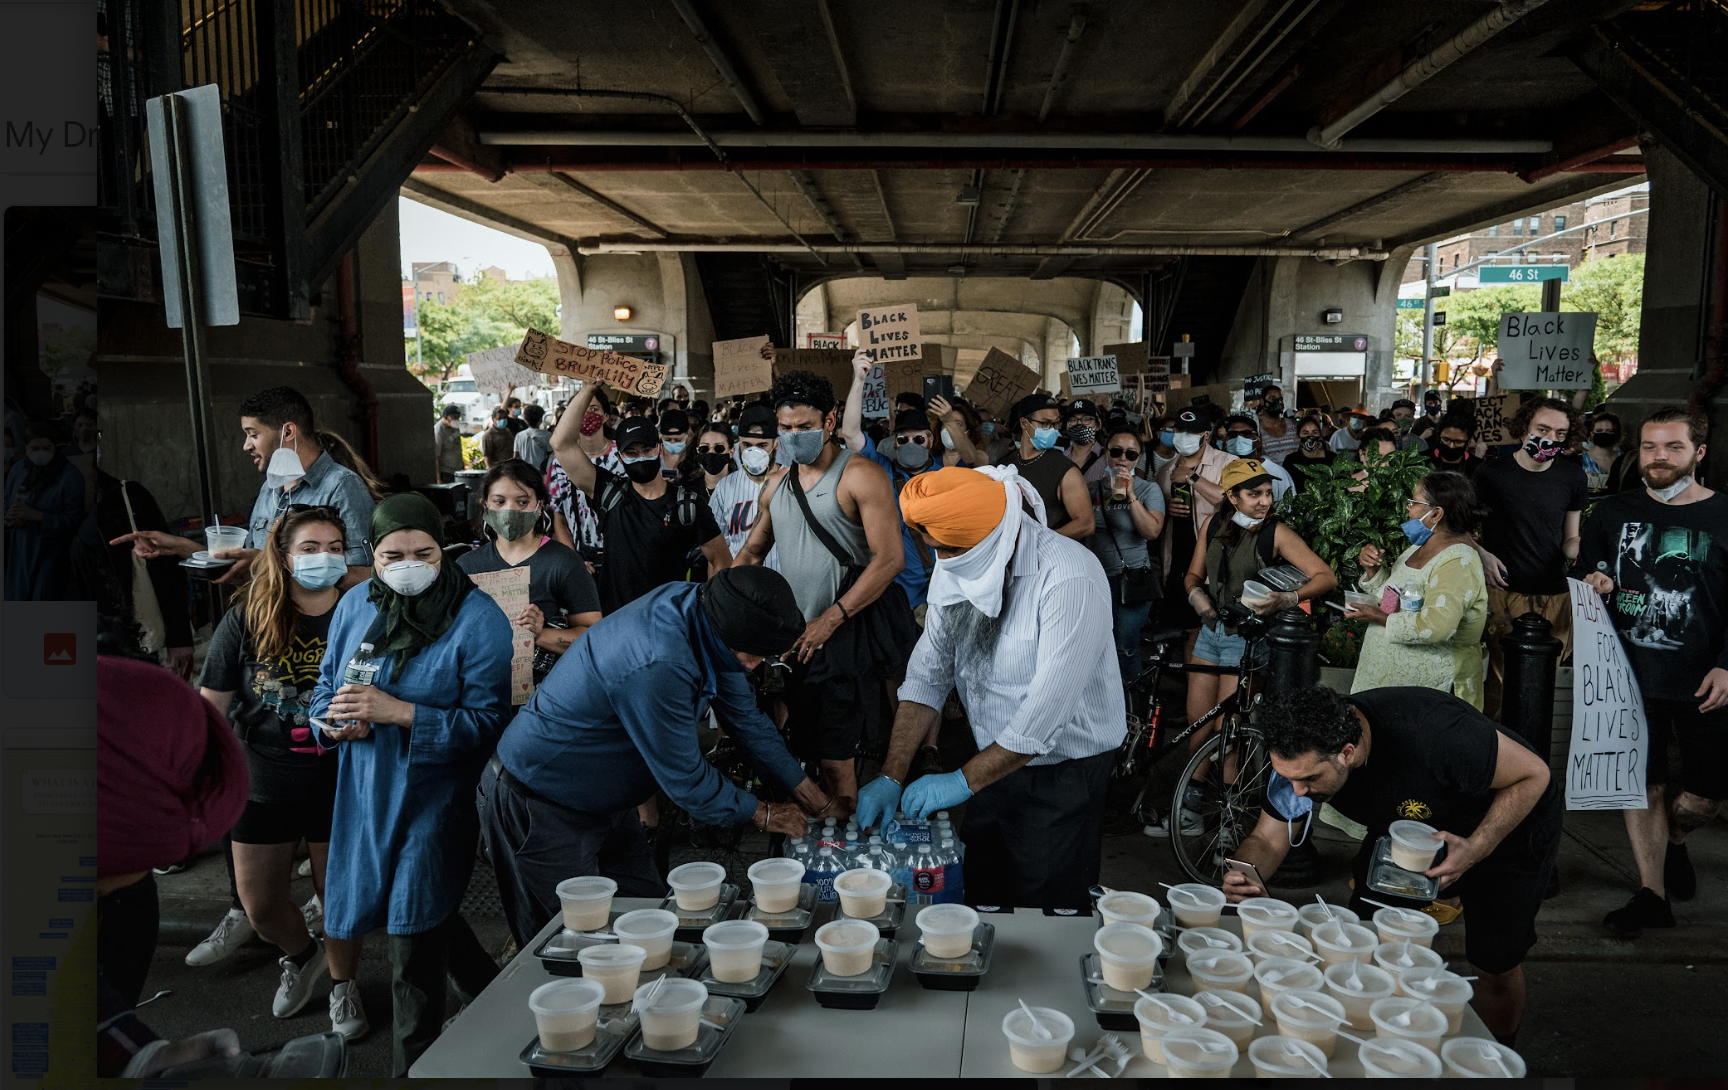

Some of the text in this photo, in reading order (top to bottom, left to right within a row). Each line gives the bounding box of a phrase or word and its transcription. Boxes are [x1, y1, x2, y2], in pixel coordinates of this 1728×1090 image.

[7, 121, 54, 155] My
[1509, 268, 1539, 280] 46 St
[1400, 300, 1412, 308] 46
[862, 312, 908, 330] BLACK
[1507, 314, 1565, 337] Black
[813, 339, 840, 350] BLACK
[870, 330, 910, 344] LIVES
[1357, 340, 1364, 348] 7
[554, 341, 597, 361] STOP
[866, 343, 918, 361] MATTER
[1529, 340, 1580, 360] Lives
[1068, 357, 1117, 373] BLACK TRANS
[1536, 365, 1587, 383] Matter.
[977, 366, 1026, 402] GREAT
[1089, 371, 1118, 384] MATTER
[1247, 461, 1257, 472] P
[1596, 631, 1621, 669] FOR
[1582, 663, 1639, 706] BLACK
[1582, 708, 1640, 742] LIVES
[1571, 748, 1641, 794] MATTER
